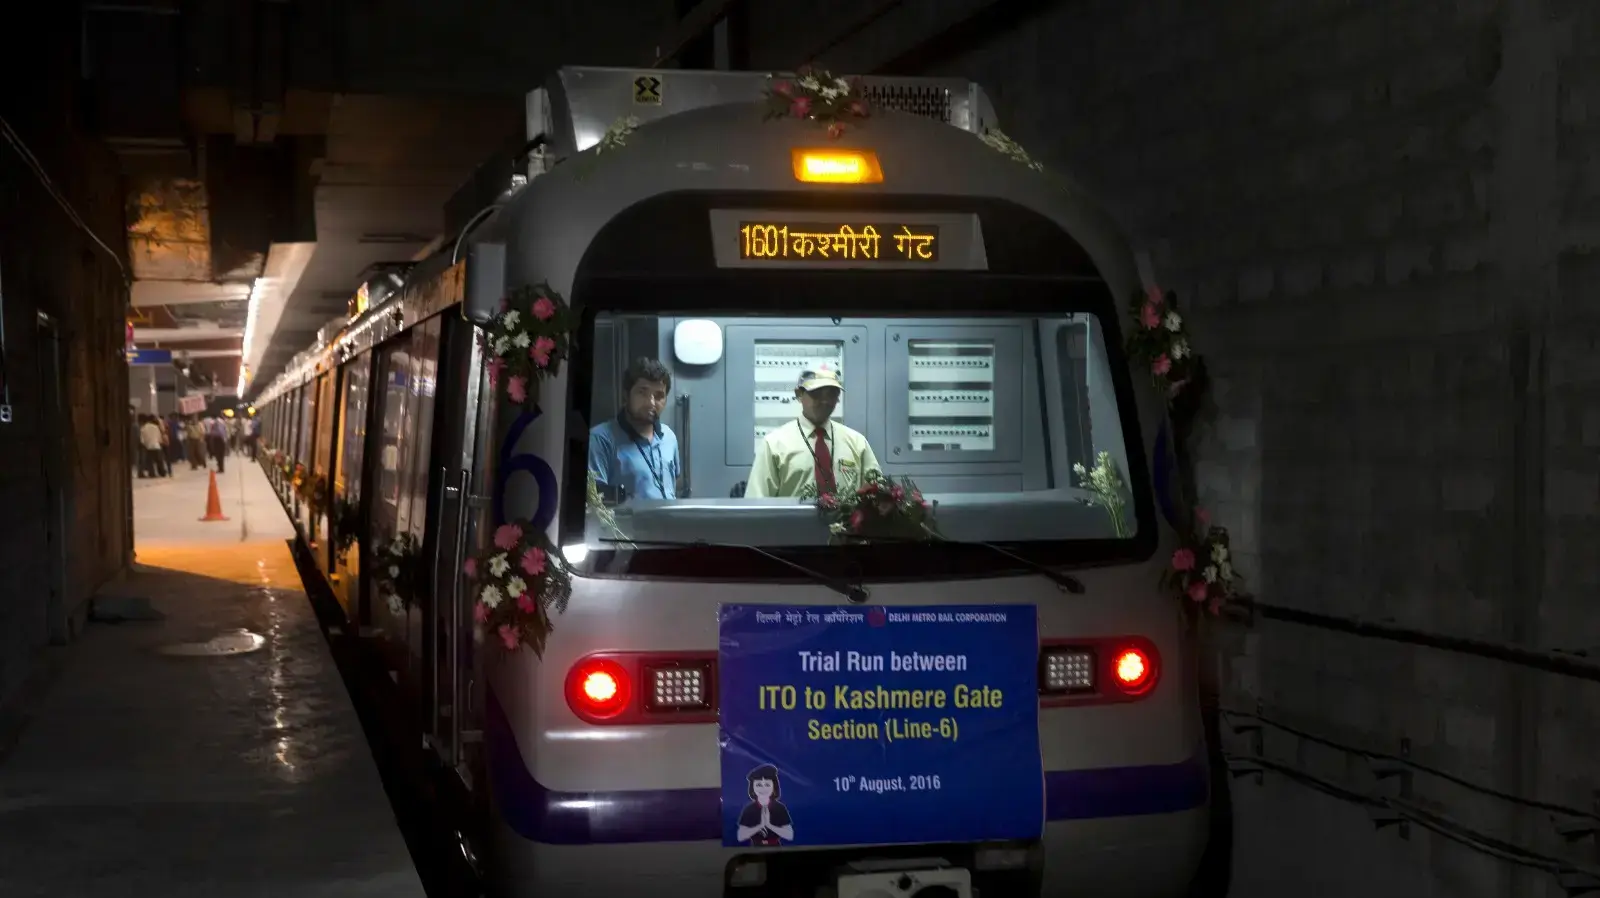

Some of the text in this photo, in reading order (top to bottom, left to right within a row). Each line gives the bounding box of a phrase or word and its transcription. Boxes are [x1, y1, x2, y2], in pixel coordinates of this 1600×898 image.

[740, 224, 935, 260] 1601 कश्मीरी गेट
[493, 404, 559, 532] 6
[755, 610, 782, 624] दिल्ली
[806, 610, 820, 624] रेल
[888, 612, 1008, 623] DELHI METRO RAIL CORPORATION
[798, 650, 967, 673] Trial Run between
[759, 684, 1003, 711] ITO to Kashmere Gate
[808, 717, 959, 743] Section (Line-6)
[859, 776, 906, 795] August,
[909, 775, 941, 791] 2016
